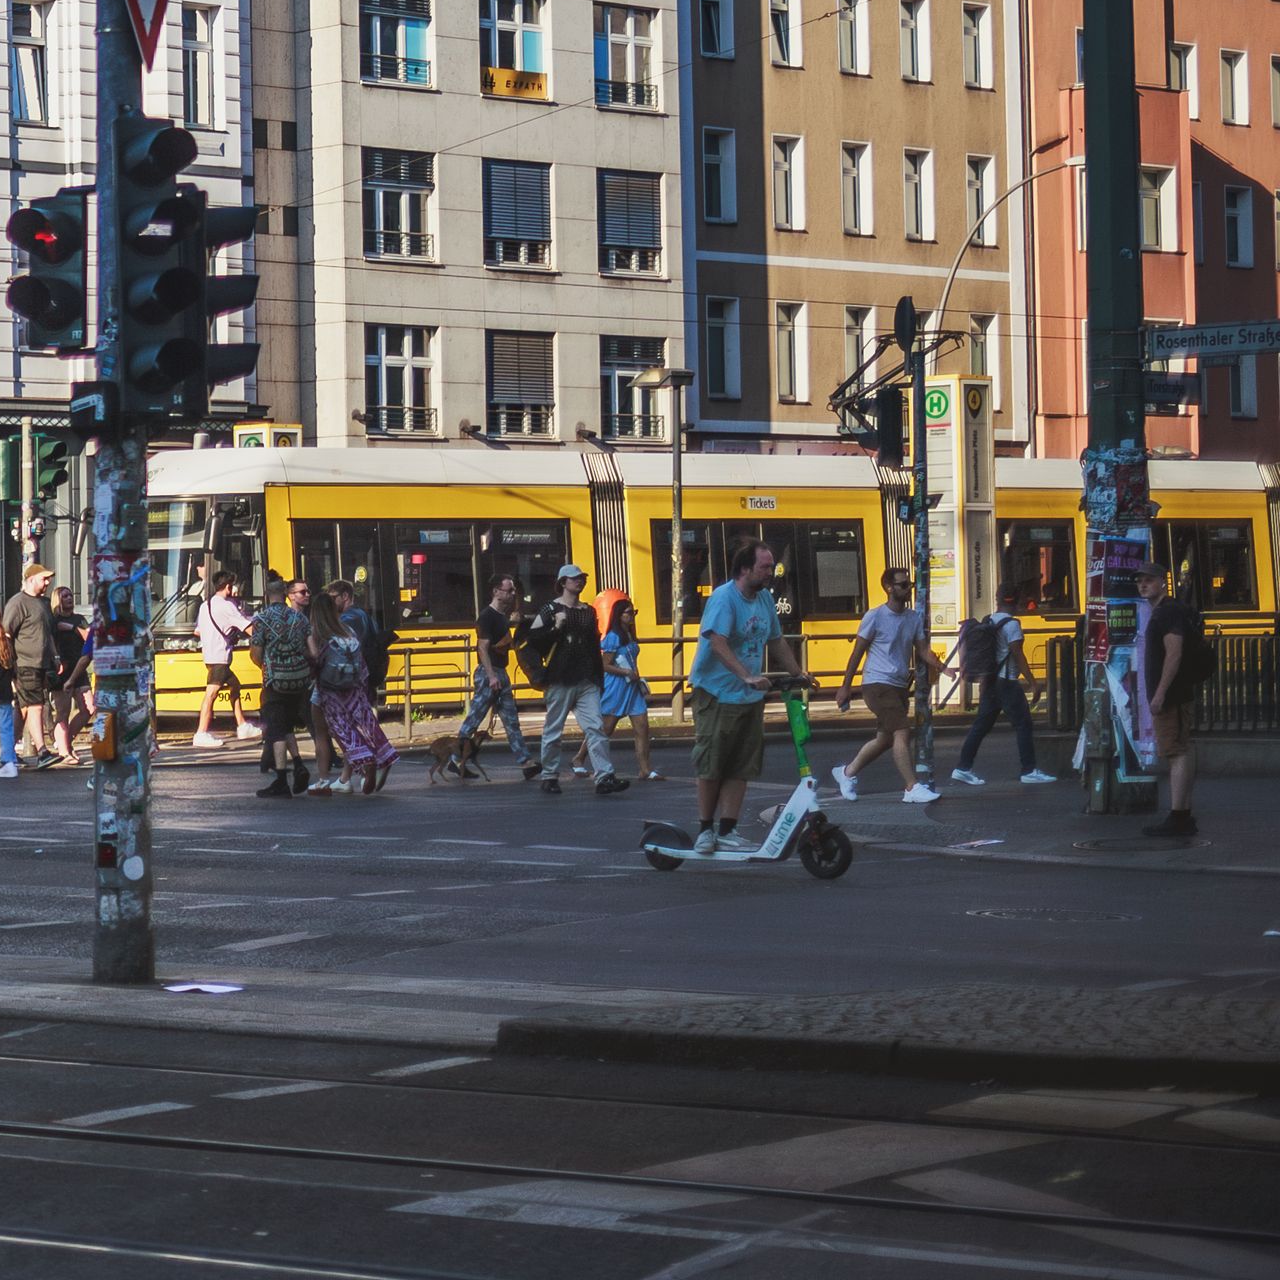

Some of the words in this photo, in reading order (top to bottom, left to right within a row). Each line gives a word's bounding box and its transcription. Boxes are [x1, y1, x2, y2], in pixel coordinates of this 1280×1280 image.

[1156, 332, 1234, 350] Rosenthaler
[1238, 327, 1280, 347] Straße
[971, 393, 977, 407] 4
[749, 497, 775, 509] Tickets
[218, 692, 252, 702] 90-A
